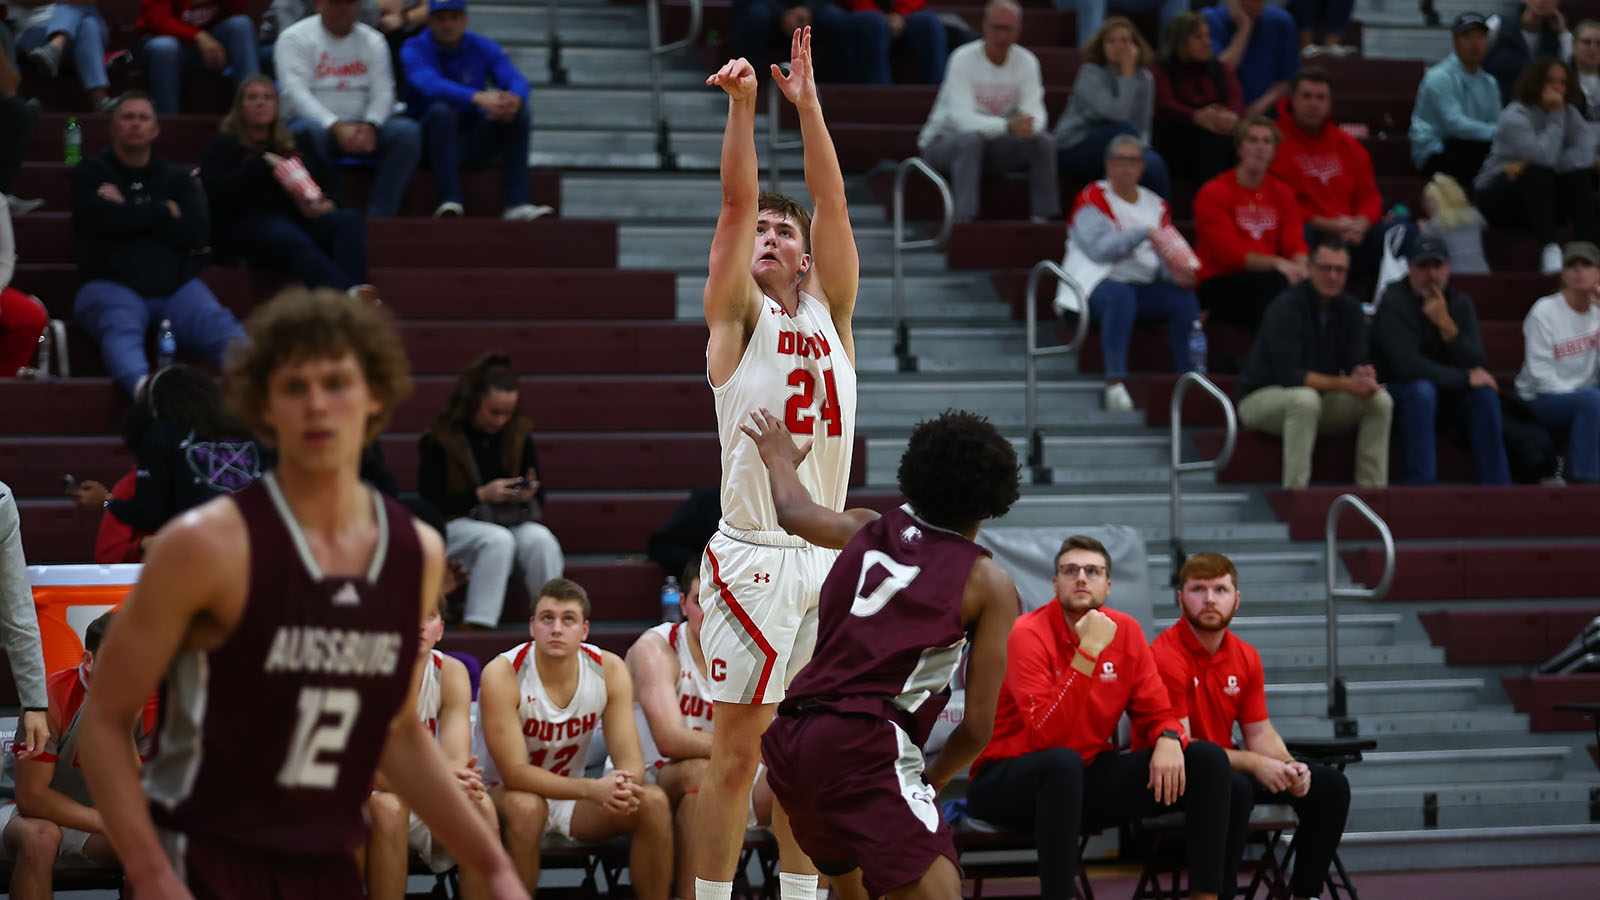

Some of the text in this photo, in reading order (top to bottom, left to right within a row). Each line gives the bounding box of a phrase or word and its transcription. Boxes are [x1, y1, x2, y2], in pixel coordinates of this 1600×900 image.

[784, 367, 843, 438] 24
[849, 548, 921, 618] 0
[711, 658, 727, 682] C
[277, 686, 361, 790] 12
[523, 712, 597, 742] DUTCH
[529, 743, 580, 778] 12
